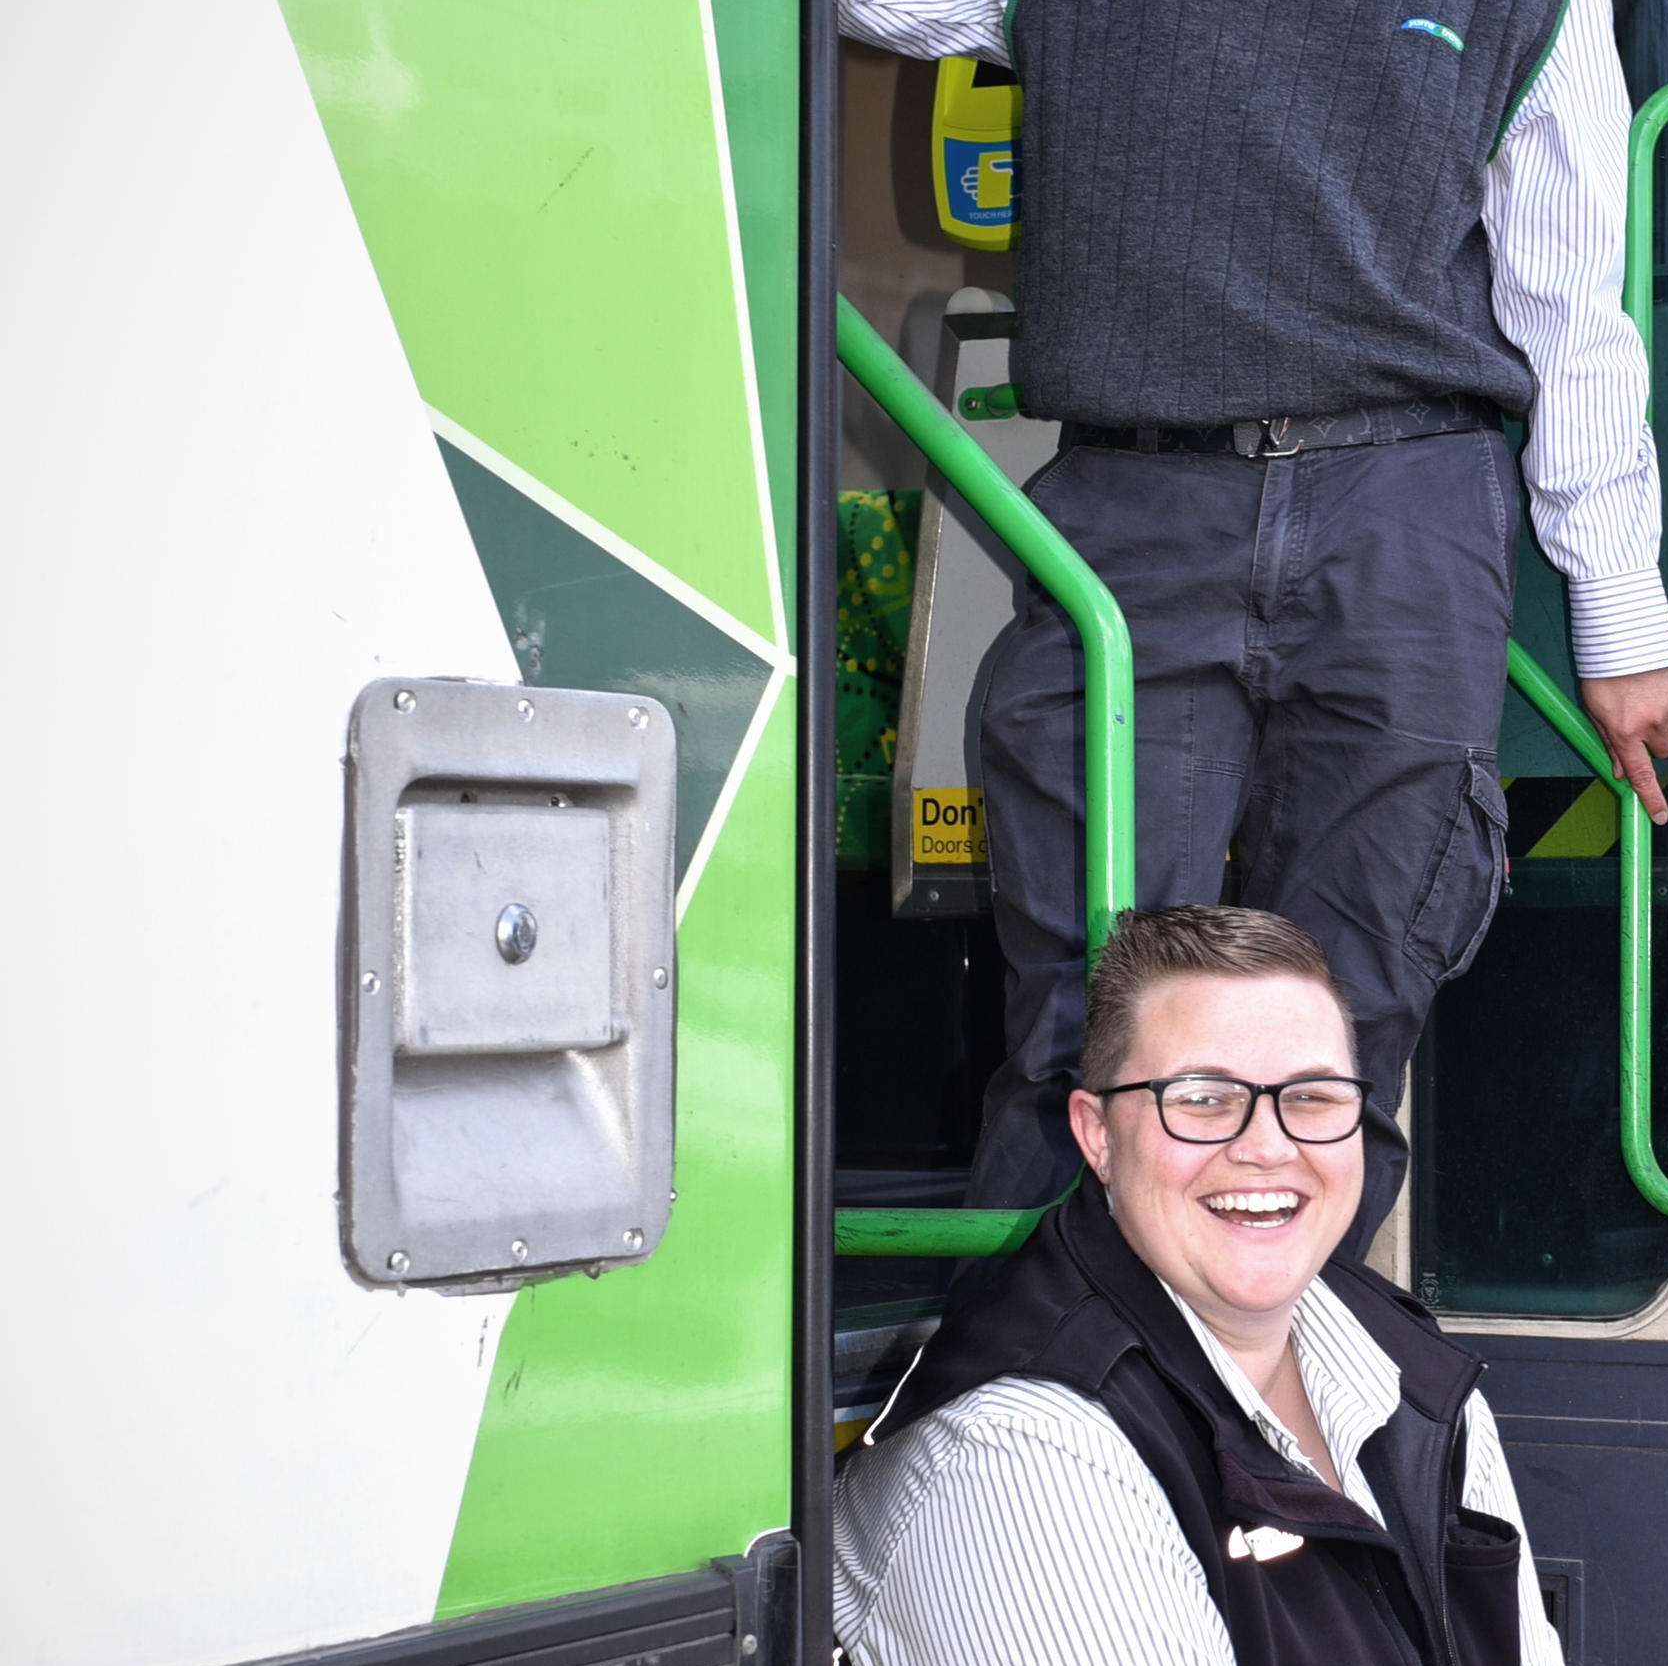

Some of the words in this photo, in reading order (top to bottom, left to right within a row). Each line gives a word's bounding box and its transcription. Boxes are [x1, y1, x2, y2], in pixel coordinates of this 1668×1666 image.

[969, 211, 997, 220] TOUCH
[922, 797, 983, 826] Don'
[922, 835, 973, 853] Doors
